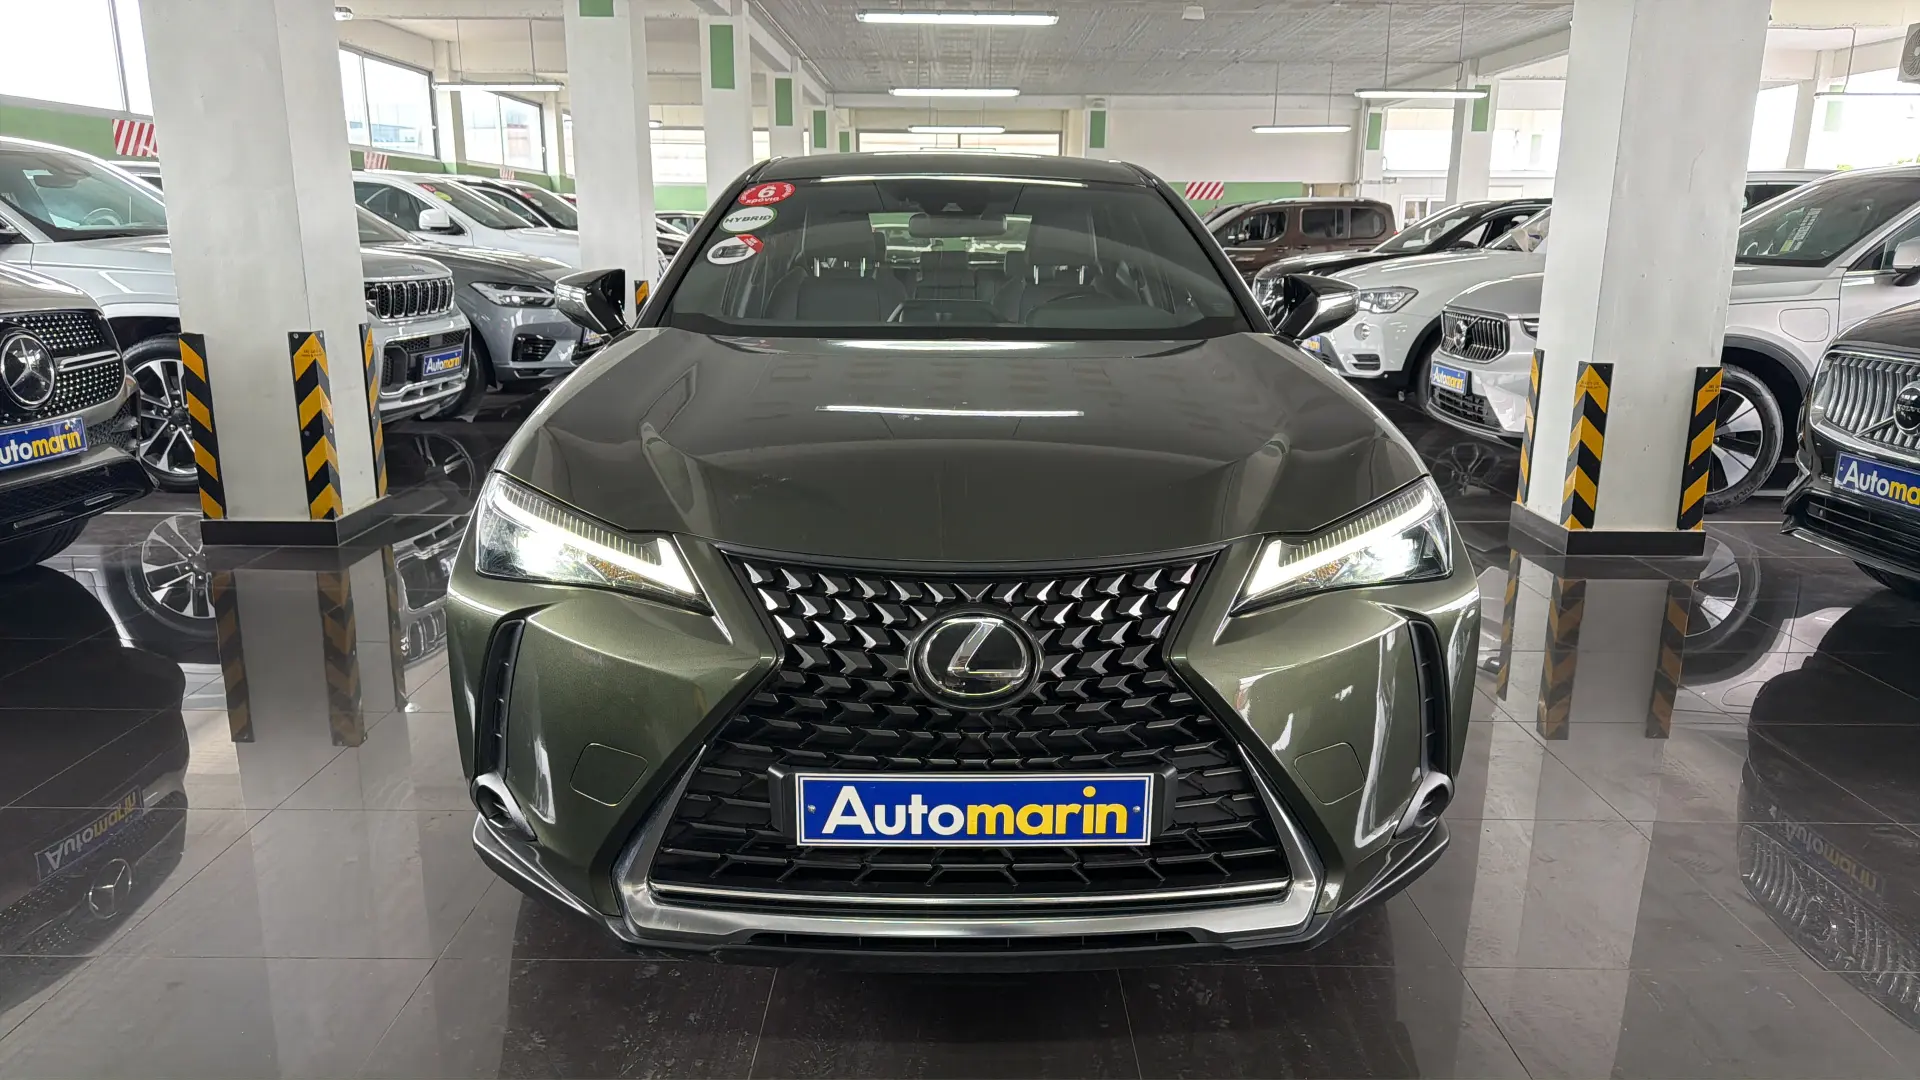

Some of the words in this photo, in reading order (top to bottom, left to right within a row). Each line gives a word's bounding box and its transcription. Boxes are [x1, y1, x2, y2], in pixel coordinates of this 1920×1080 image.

[757, 186, 776, 198] 6
[725, 215, 771, 224] HYBRID
[0, 425, 81, 464] utomarin
[1843, 461, 1920, 505] Automa
[821, 785, 1128, 835] Automarin
